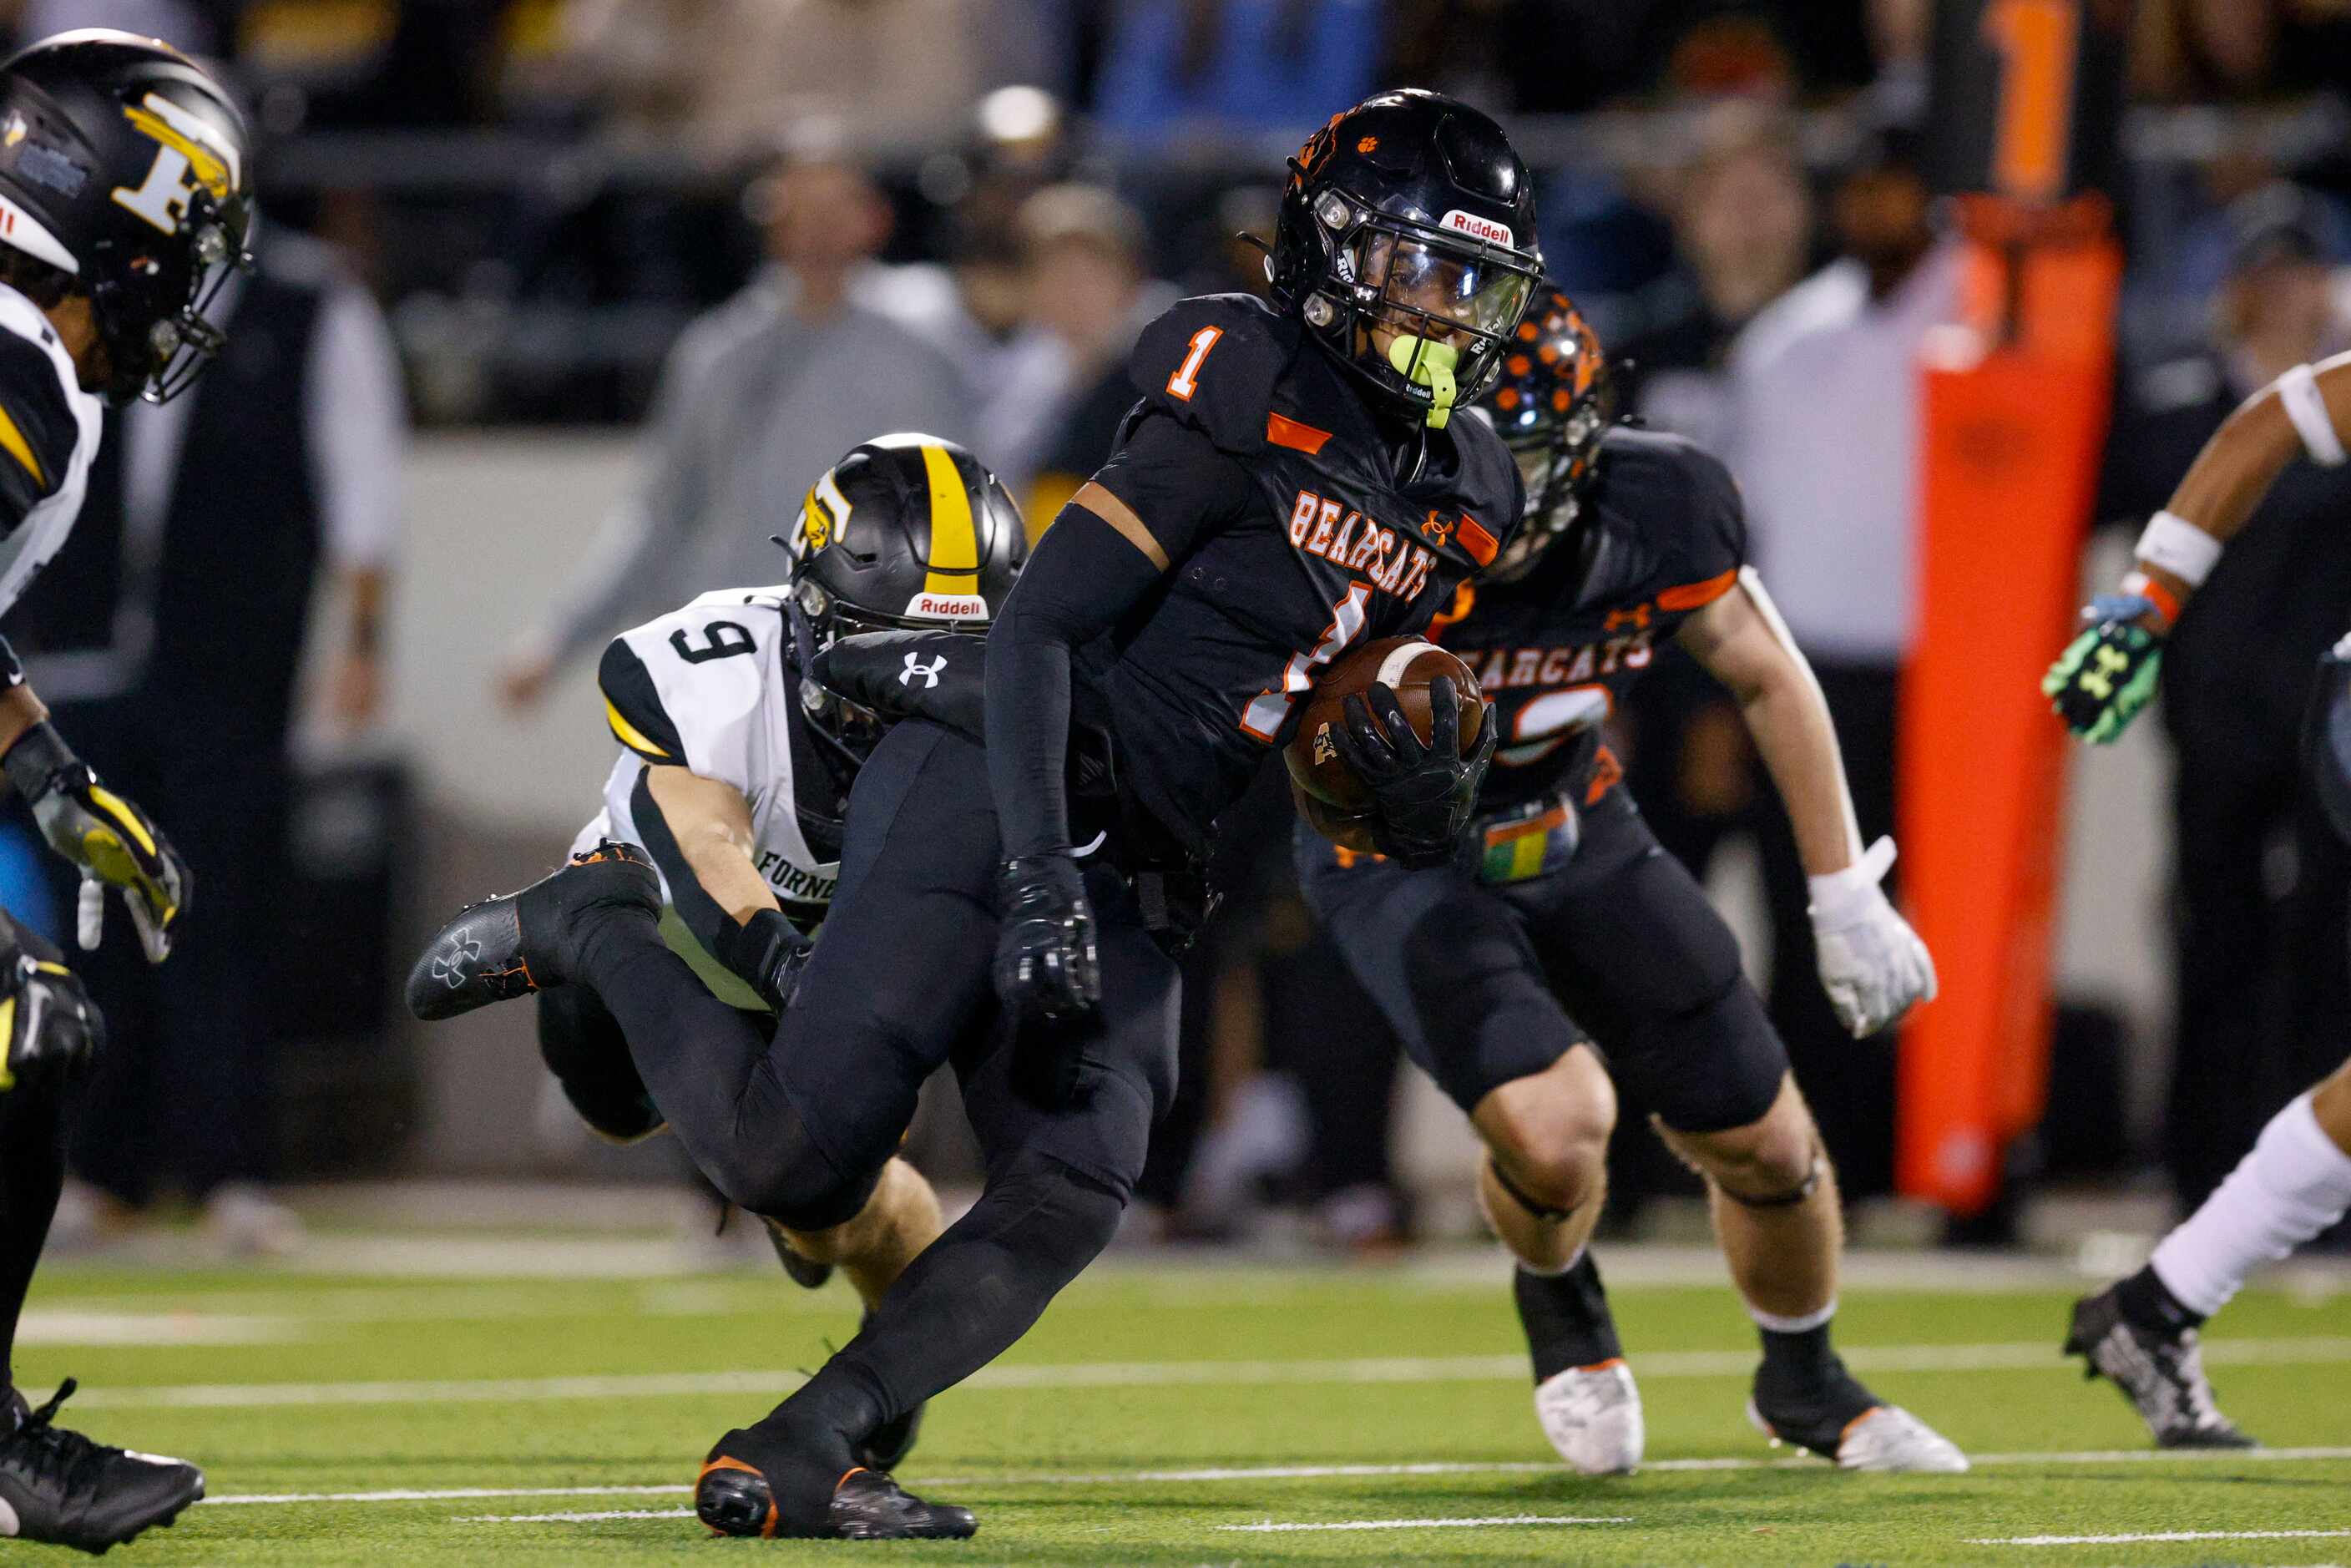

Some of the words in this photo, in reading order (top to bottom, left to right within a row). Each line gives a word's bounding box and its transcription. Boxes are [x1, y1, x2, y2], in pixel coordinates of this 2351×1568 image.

[1454, 214, 1509, 244] Riddell
[1469, 314, 1504, 355] Riell
[1165, 325, 1224, 402] 1
[1289, 489, 1438, 603] BEARCATS
[920, 598, 980, 615] Riddell
[669, 620, 758, 665] 9
[1239, 579, 1374, 745] 1
[1454, 628, 1656, 690] ARCATS
[757, 850, 838, 899] FORNE
